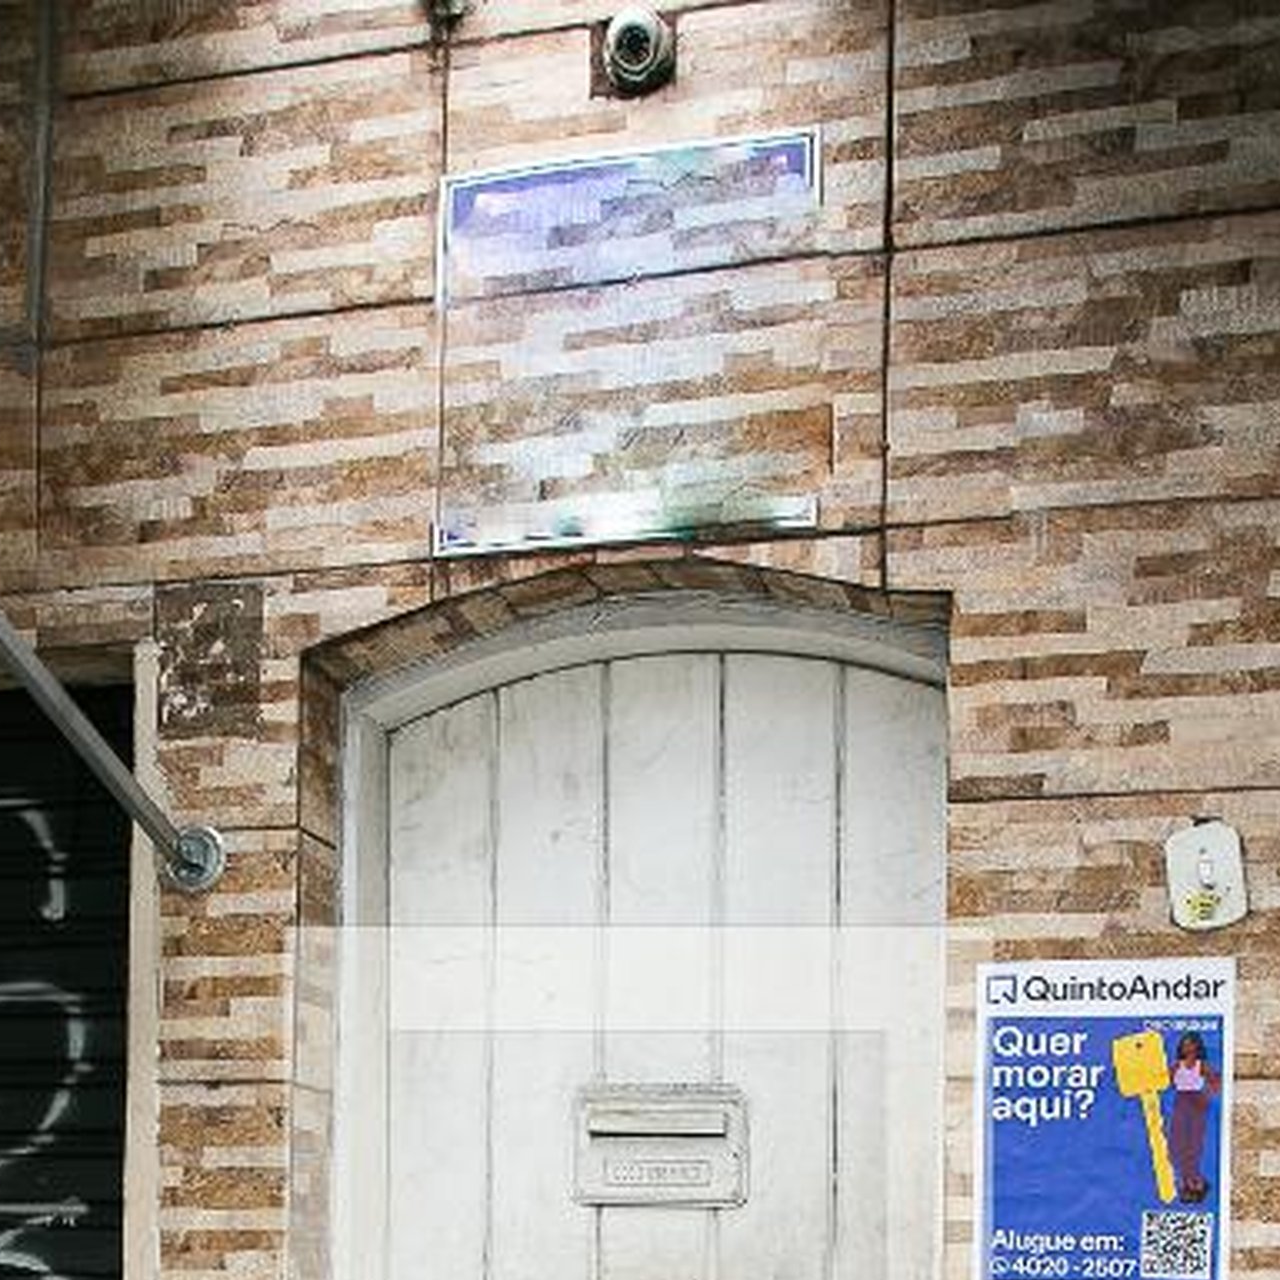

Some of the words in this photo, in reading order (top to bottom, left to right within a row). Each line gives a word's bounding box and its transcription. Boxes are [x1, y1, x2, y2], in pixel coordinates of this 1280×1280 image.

[1023, 974, 1227, 1003] QuintoAndar
[993, 1025, 1088, 1057] Quer
[992, 1064, 1105, 1088] morar
[991, 1089, 1095, 1127] aqui?
[991, 1228, 1077, 1254] Alugue
[1079, 1232, 1125, 1252] em:
